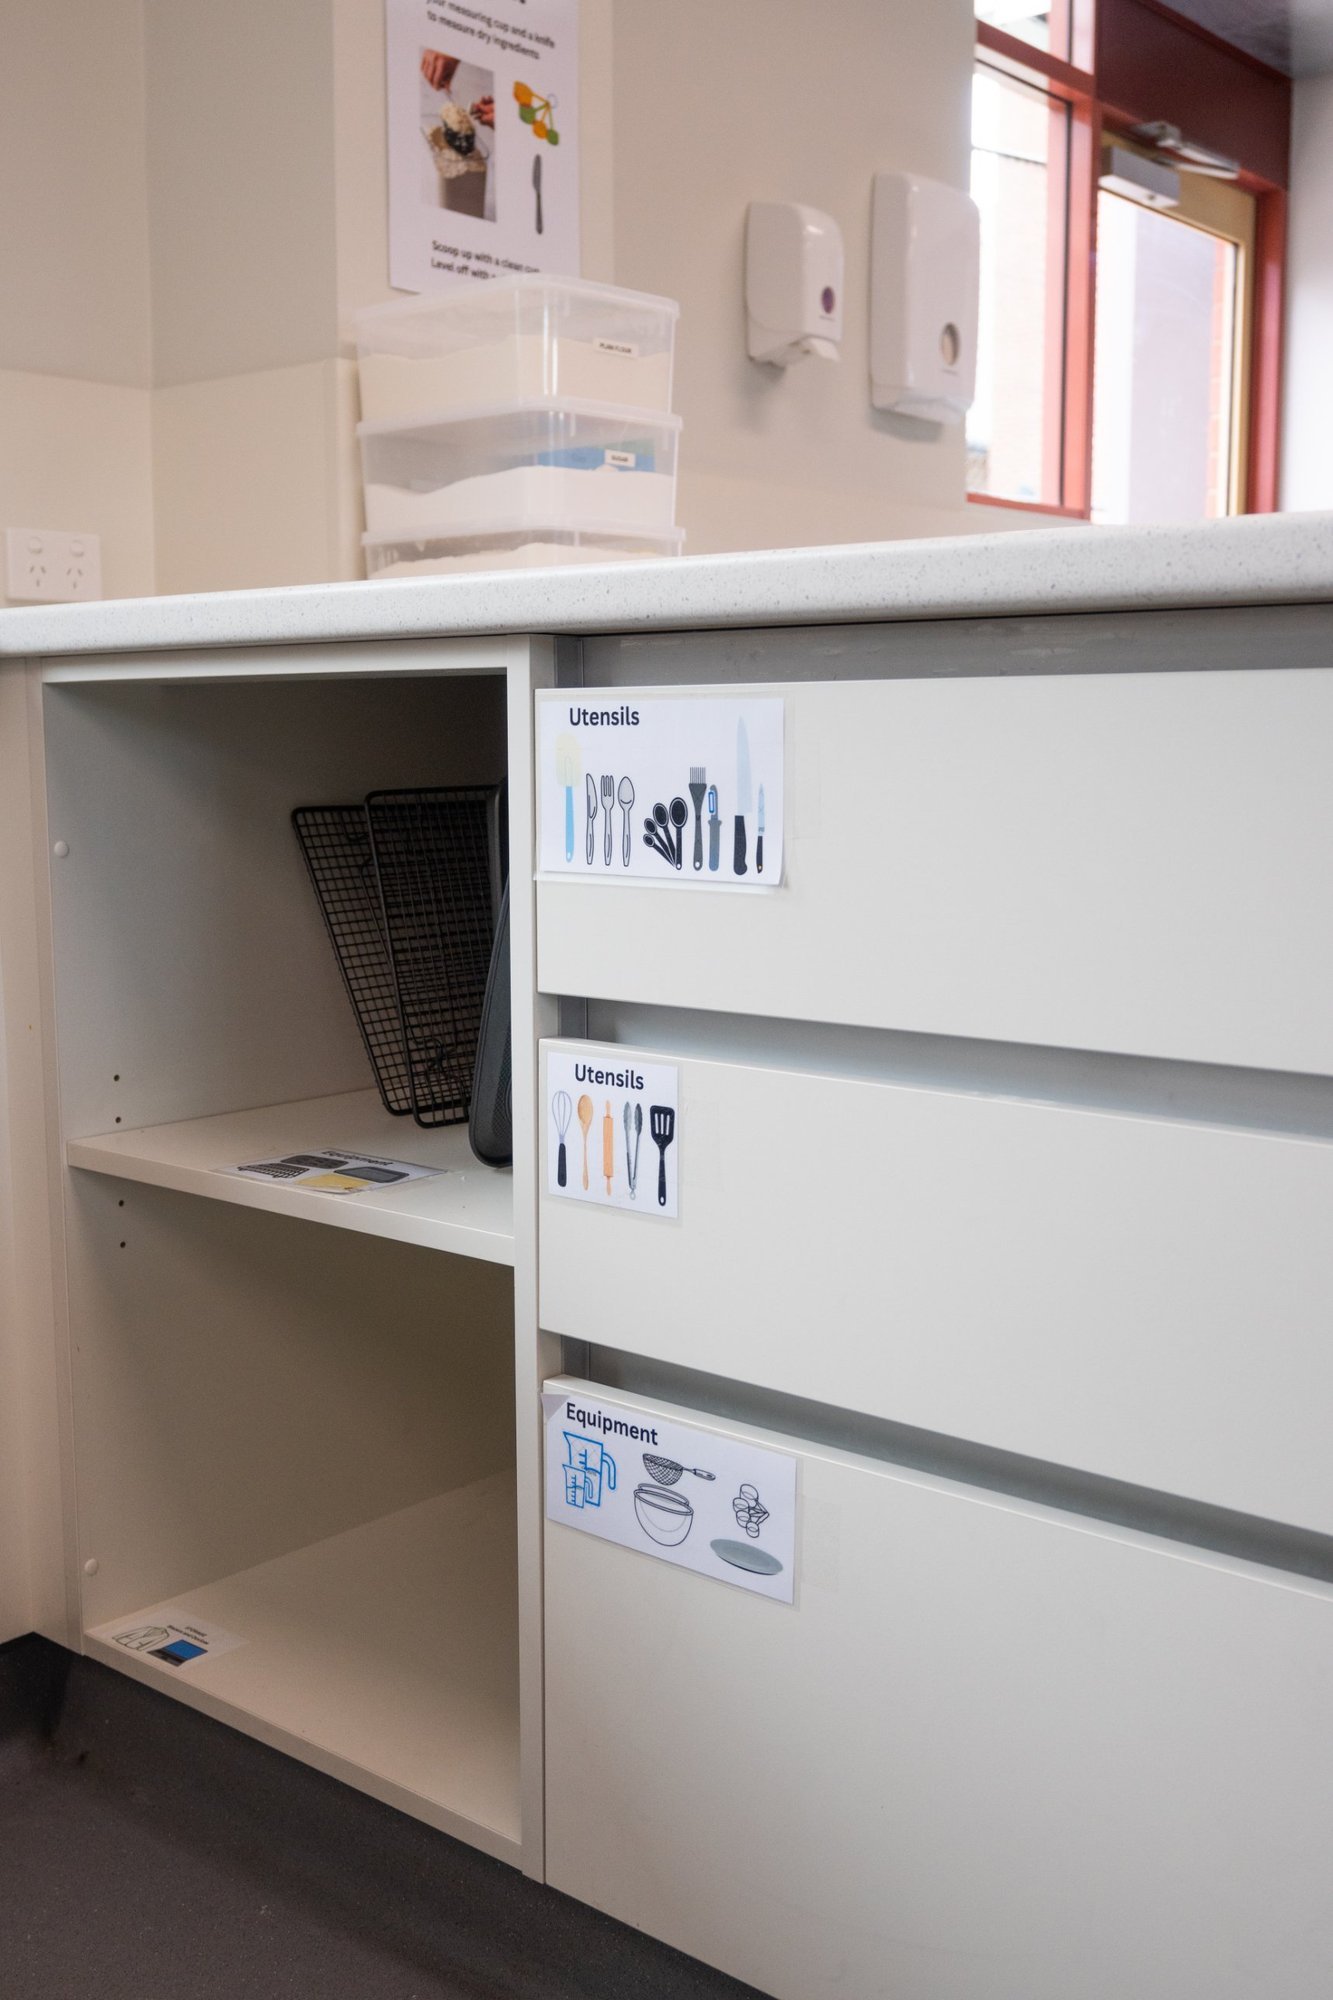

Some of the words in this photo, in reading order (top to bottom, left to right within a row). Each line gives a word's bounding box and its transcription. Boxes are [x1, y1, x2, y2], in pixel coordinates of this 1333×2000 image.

[426, 10, 437, 21] to
[438, 16, 475, 36] measure
[477, 29, 491, 45] dry
[447, 2, 492, 28] measuring
[493, 19, 509, 32] cup
[511, 26, 527, 38] and
[534, 32, 555, 48] knife
[431, 240, 459, 257] Scoop
[460, 250, 472, 260] up
[474, 251, 492, 264] with
[430, 257, 454, 271] Level
[456, 263, 469, 275] off
[569, 706, 640, 726] Utensils
[574, 1063, 644, 1090] Utensils
[321, 1150, 395, 1166] Equipment
[566, 1402, 659, 1446] Equipment
